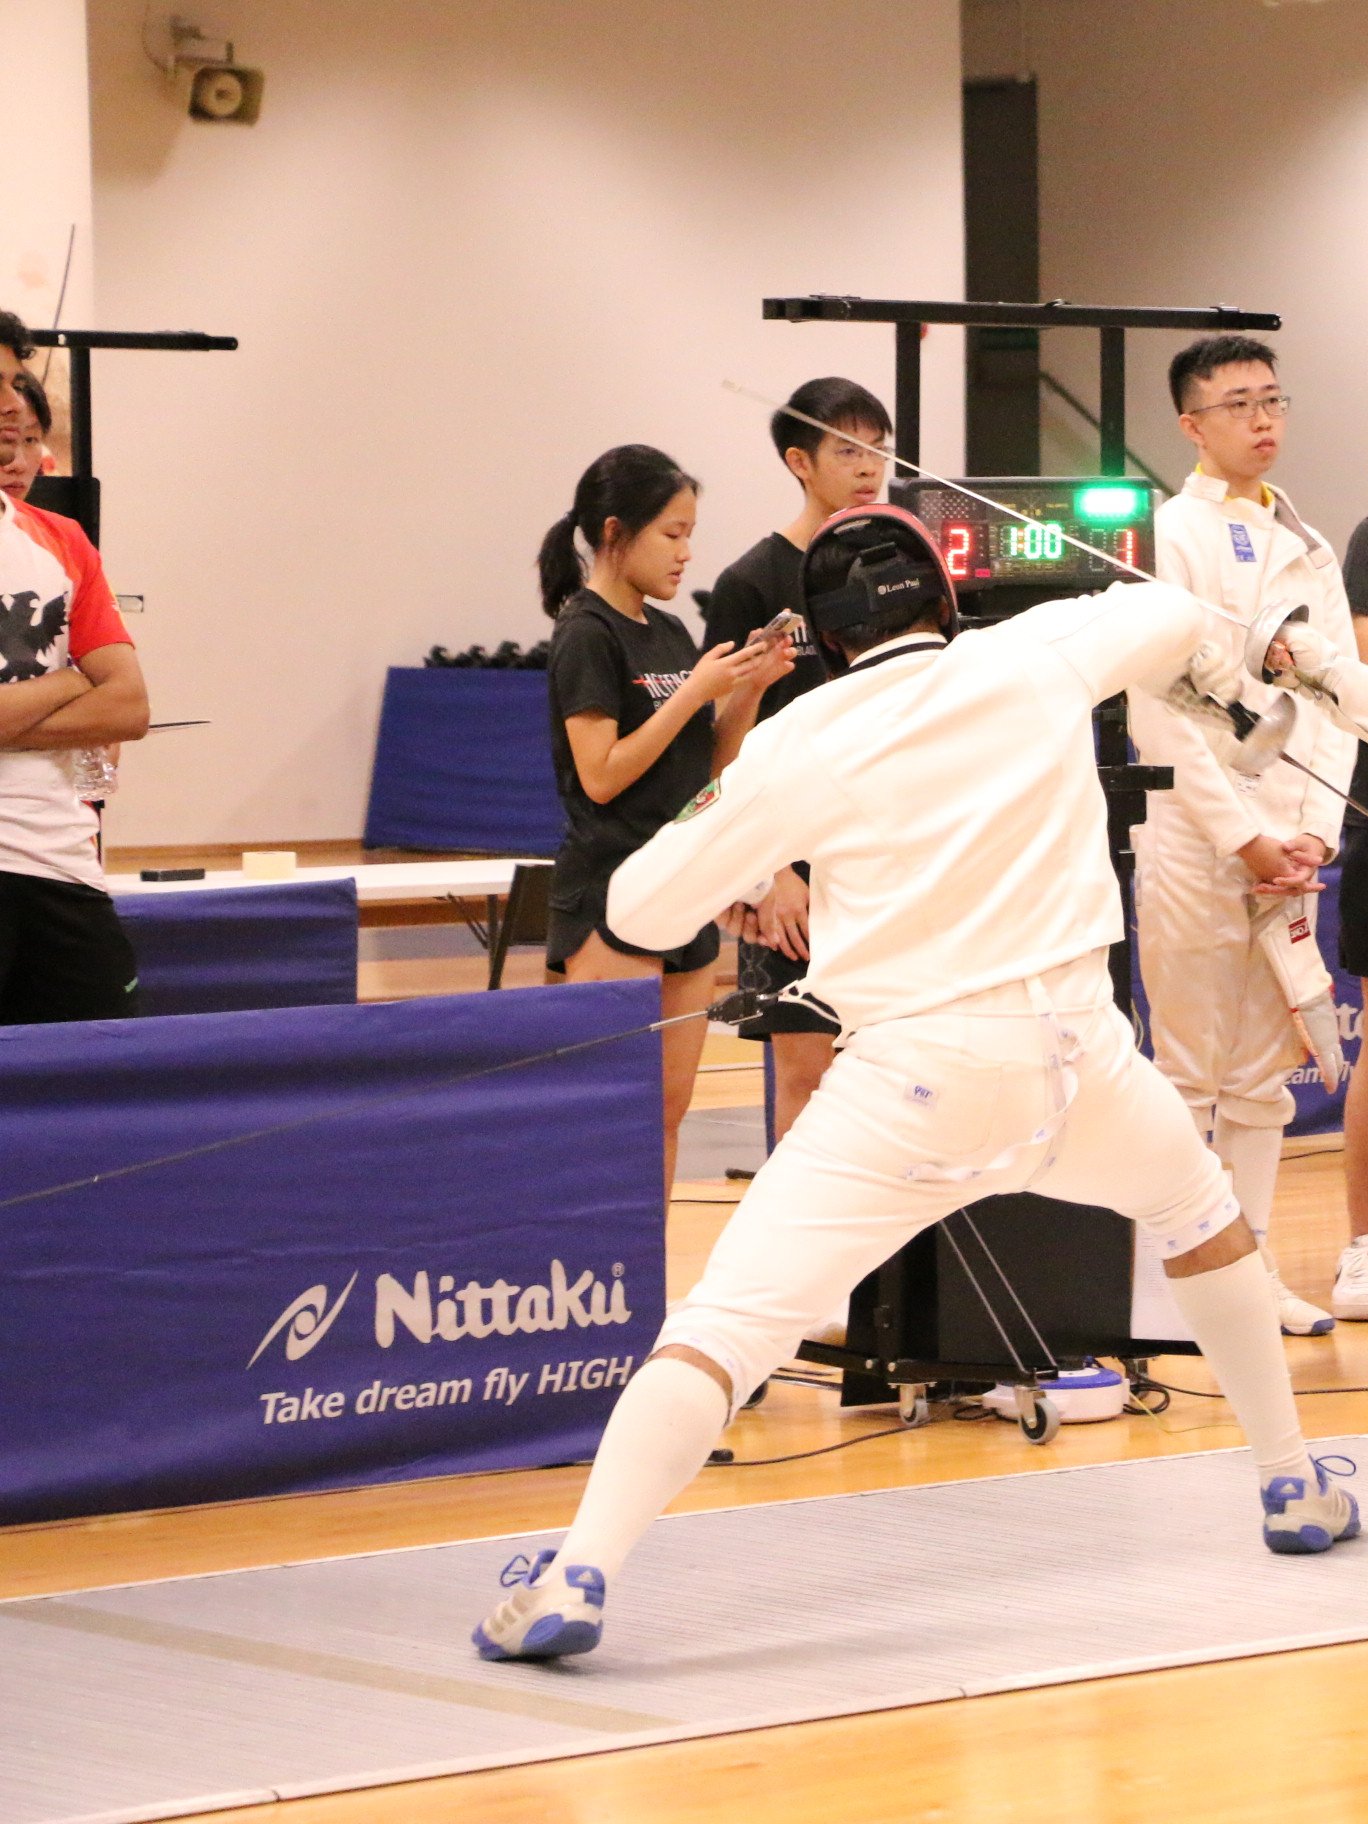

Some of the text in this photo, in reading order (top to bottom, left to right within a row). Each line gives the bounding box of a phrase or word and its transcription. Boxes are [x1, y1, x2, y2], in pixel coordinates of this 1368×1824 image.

[948, 528, 970, 575] 2
[1009, 524, 1062, 560] 1:00
[375, 1259, 632, 1349] Nittaku
[260, 1356, 634, 1425] Take dream fly HIGH
